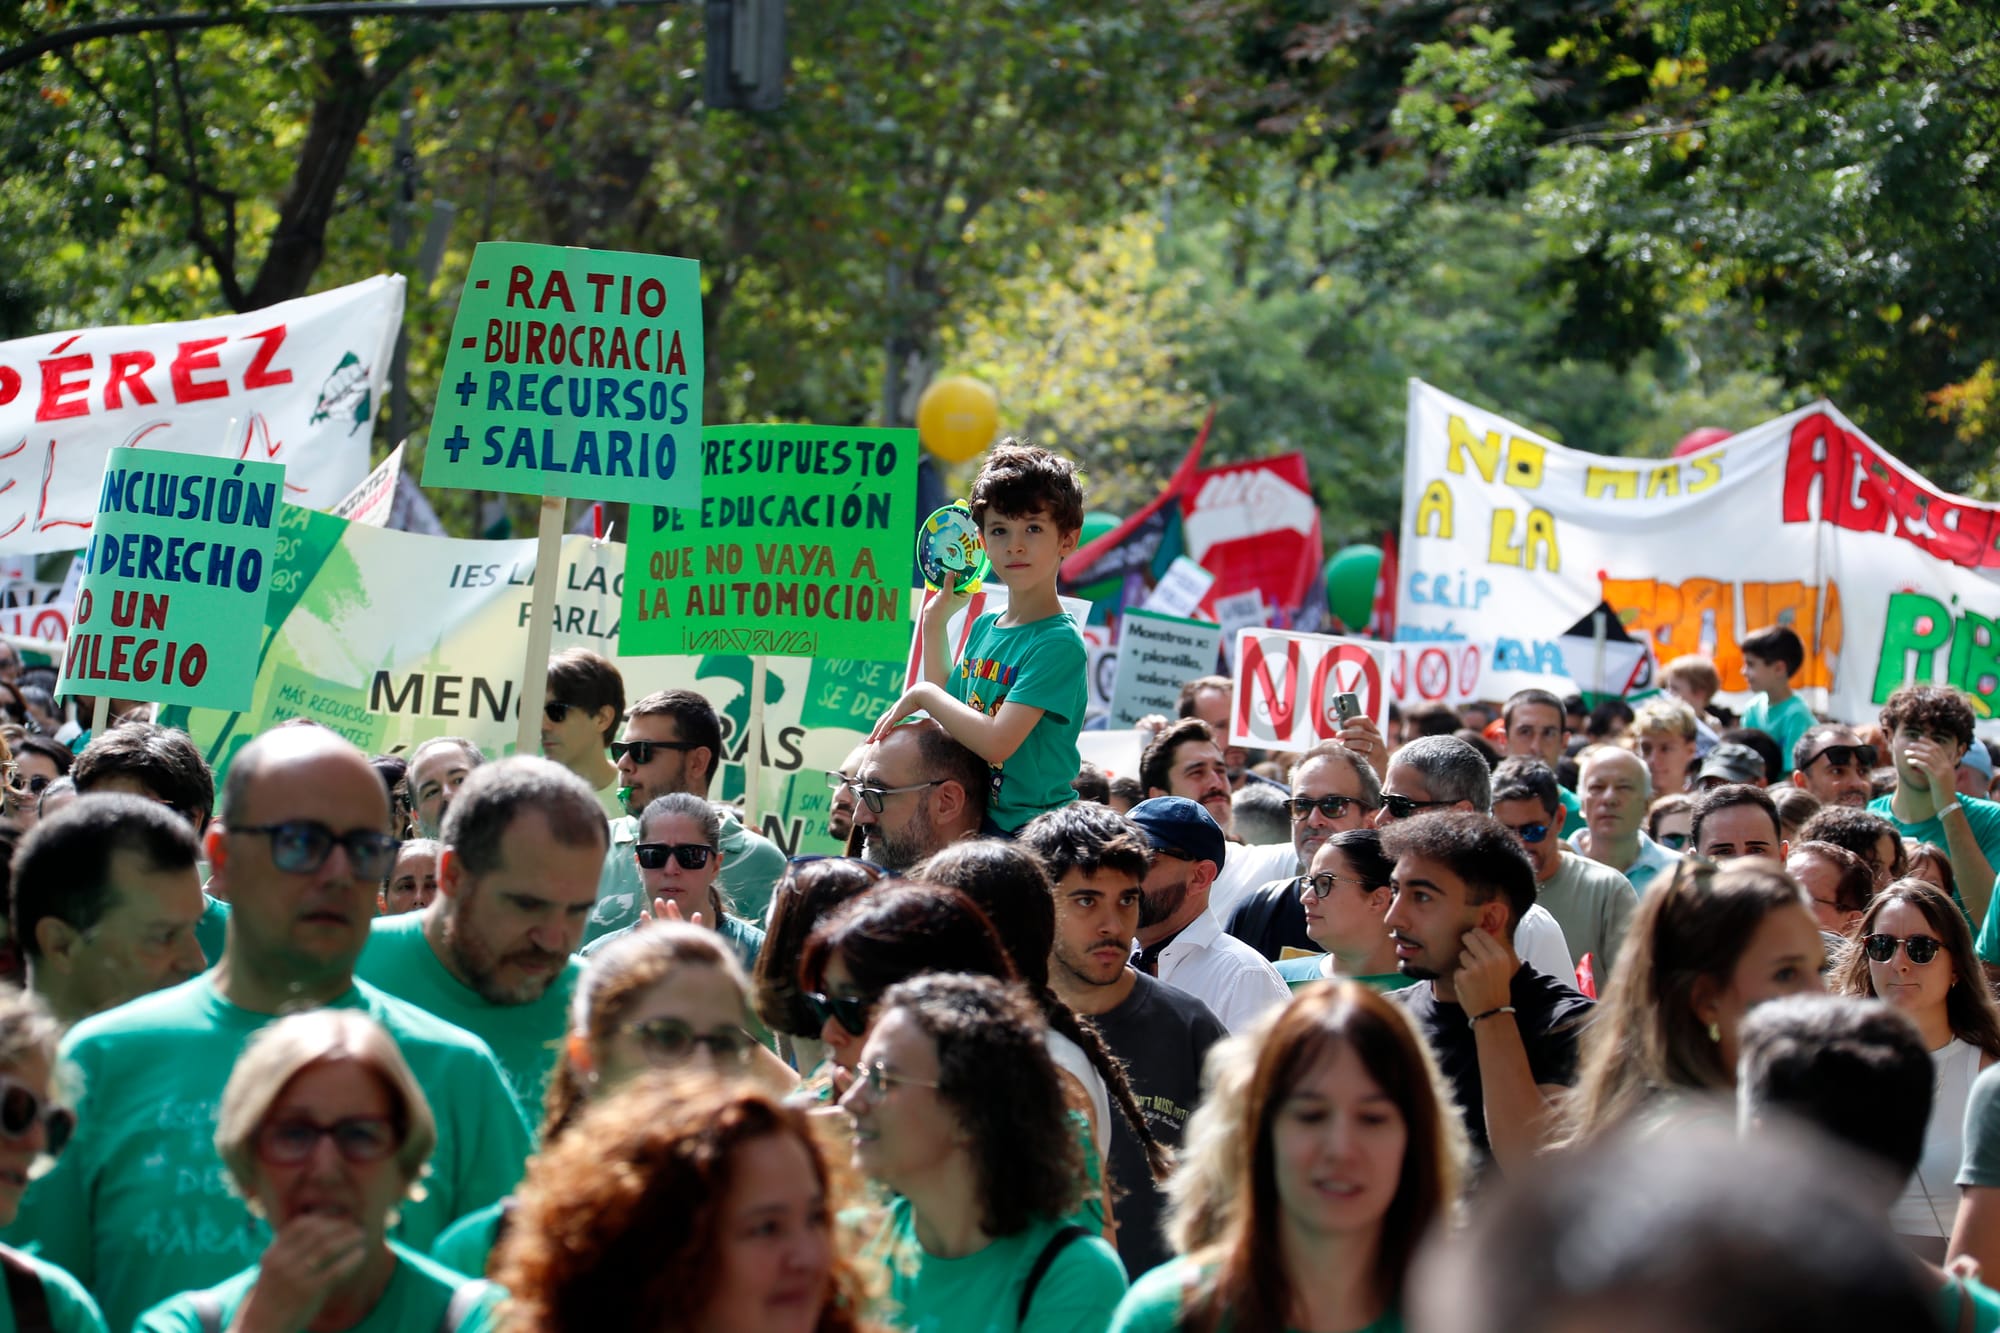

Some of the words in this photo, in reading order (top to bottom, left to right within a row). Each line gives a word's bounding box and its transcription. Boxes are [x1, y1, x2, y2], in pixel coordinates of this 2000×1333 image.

[506, 265, 667, 318] RATIO
[484, 318, 687, 375] BUROCRACIA
[486, 370, 689, 425] RECURSOS
[482, 425, 677, 480] SALARIO
[701, 439, 898, 476] RESUPUESTO
[1447, 413, 1547, 490] NO
[1585, 450, 1726, 500] MAS
[98, 463, 277, 528] INCLUSIÓN
[653, 505, 684, 533] DE
[700, 483, 892, 529] EDUCACIÓN
[1416, 479, 1454, 539] A
[1487, 508, 1561, 573] LA
[100, 534, 263, 593] DERECHO
[449, 564, 501, 588] IES
[650, 547, 694, 582] QUE
[706, 544, 743, 575] NO
[756, 543, 836, 578] VAYA
[851, 547, 878, 580] A
[111, 590, 169, 631] UN
[638, 587, 671, 622] LA
[685, 578, 899, 622] AUTOMOCIÓN
[65, 634, 208, 687] VILEGIO
[857, 660, 884, 687] SE
[889, 669, 906, 696] V
[278, 684, 306, 705] MÁS
[308, 694, 374, 726] RECURSOS
[370, 670, 521, 722] MEN
[818, 682, 849, 709] SE
[1236, 636, 1382, 742] NO
[720, 715, 806, 770] RAS
[800, 794, 824, 811] SIN
